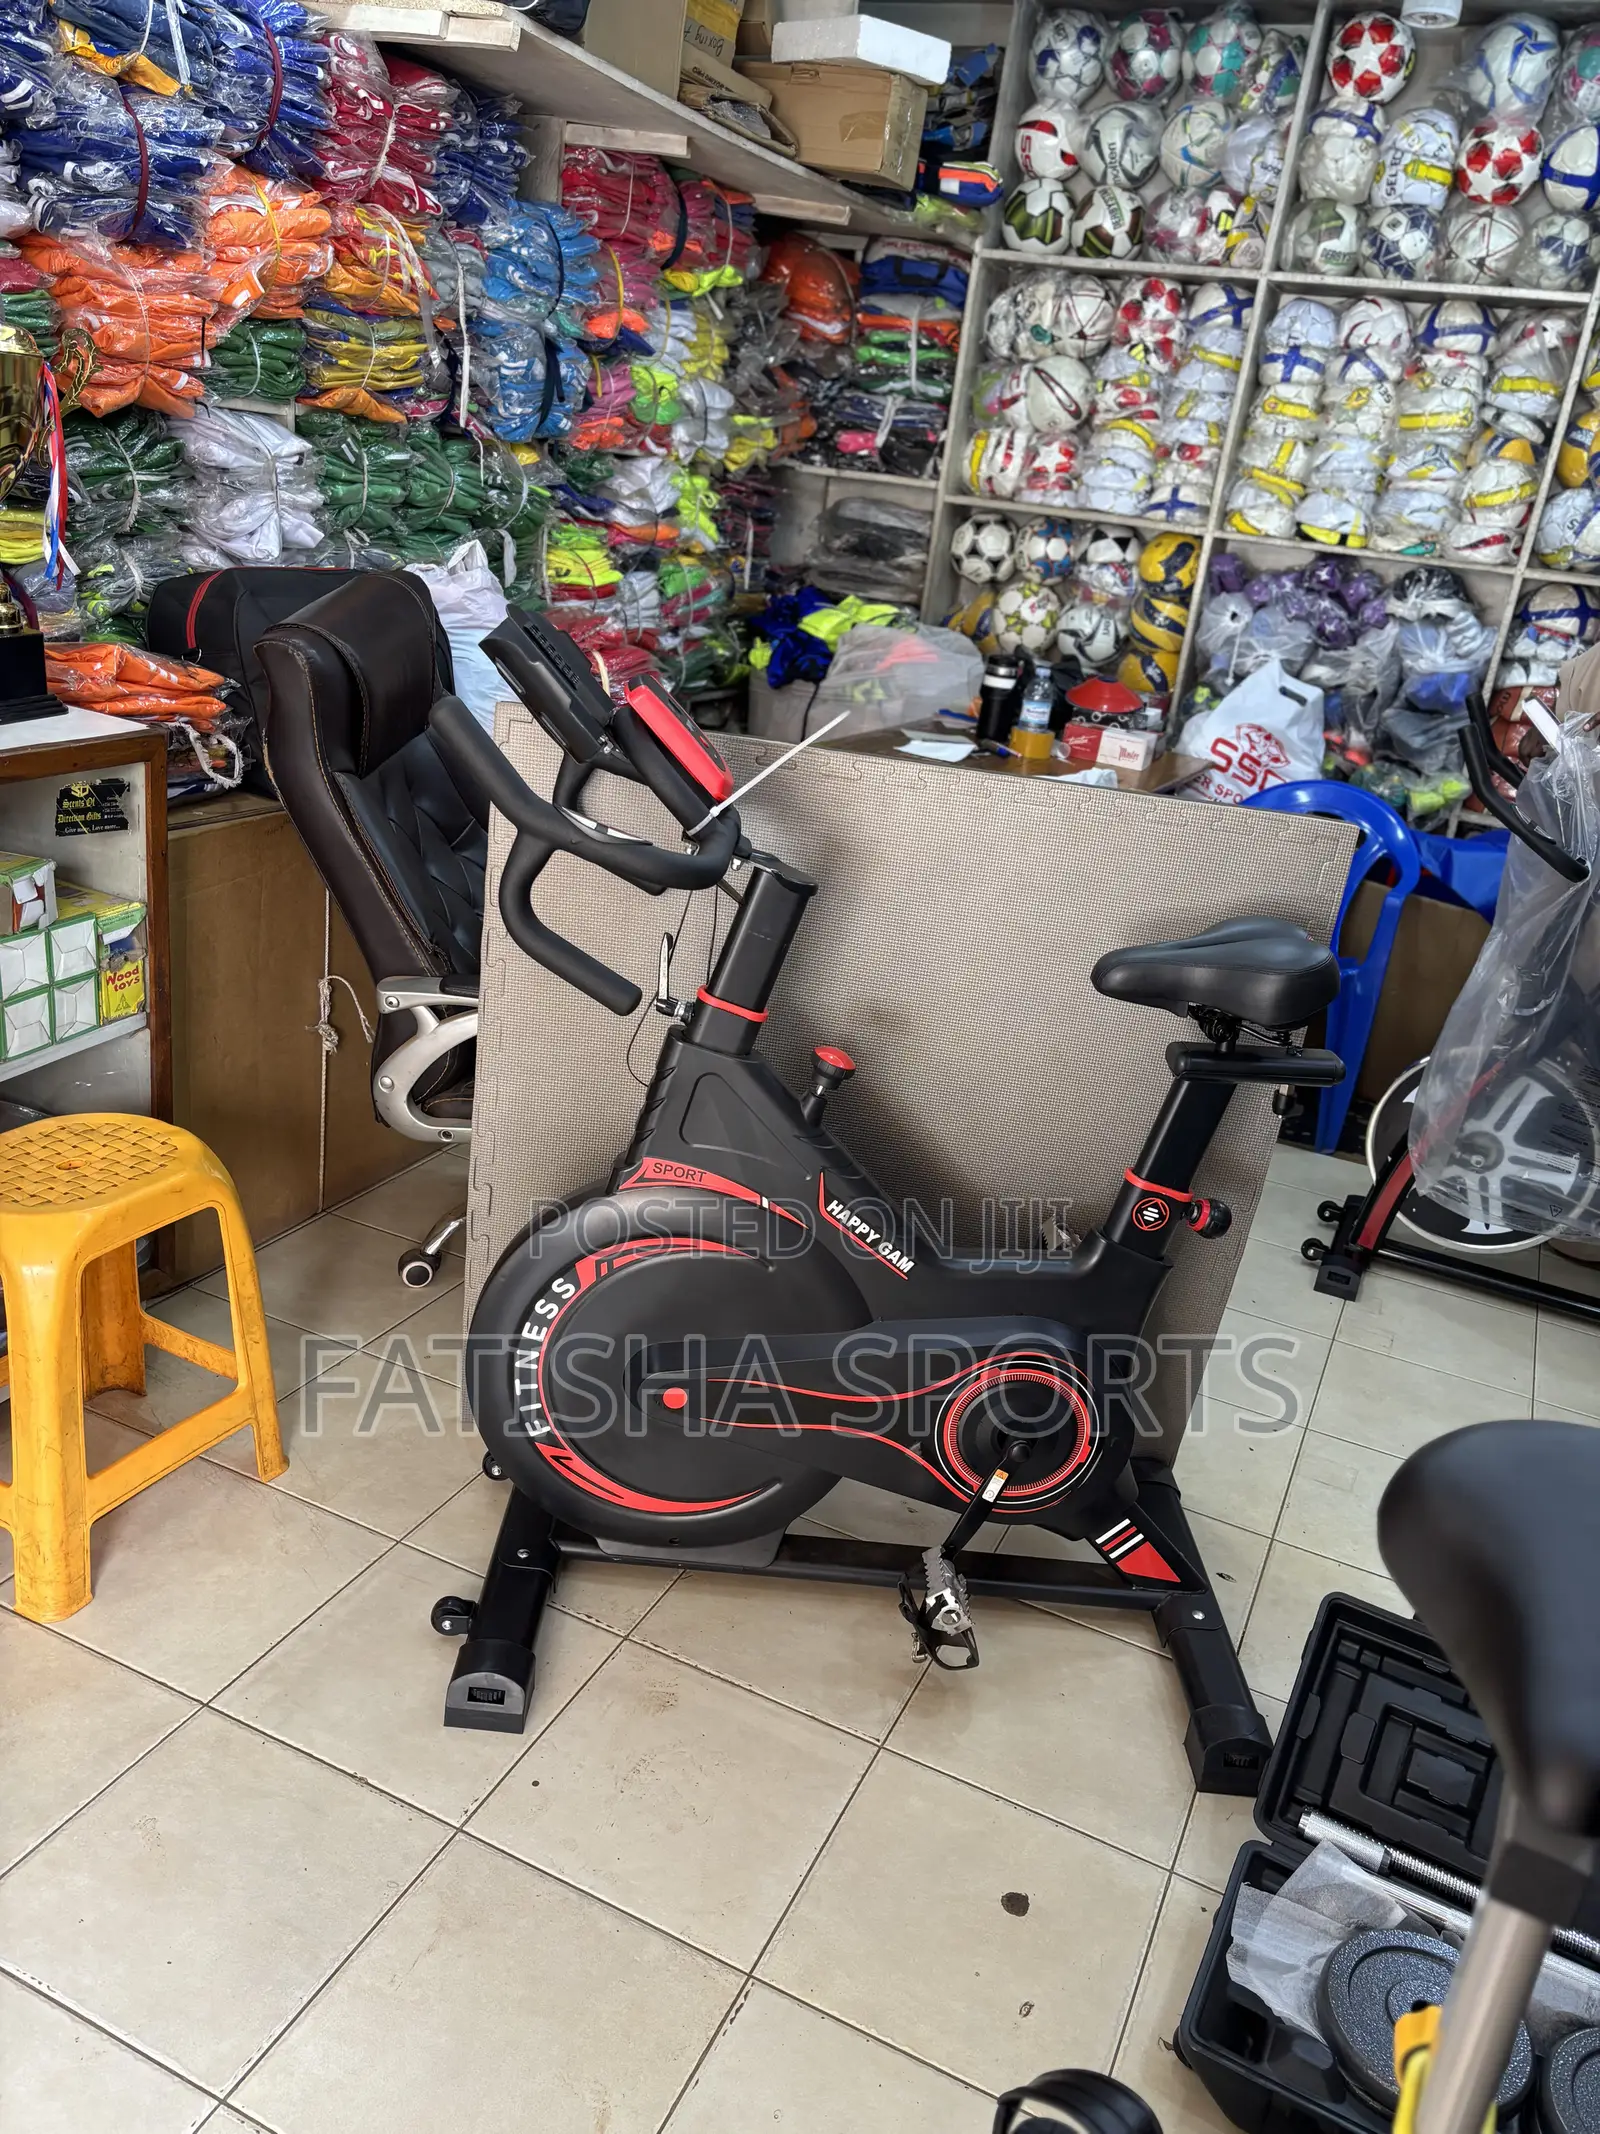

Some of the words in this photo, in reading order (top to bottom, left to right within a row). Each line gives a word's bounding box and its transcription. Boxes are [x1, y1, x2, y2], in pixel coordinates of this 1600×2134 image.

[1108, 142, 1121, 185] molten
[107, 965, 140, 986] Wood
[114, 976, 141, 992] toys
[652, 1162, 707, 1183] SPORT
[826, 1199, 881, 1245] HAPPY
[876, 1241, 915, 1274] GAM
[515, 1277, 576, 1437] FITNESS
